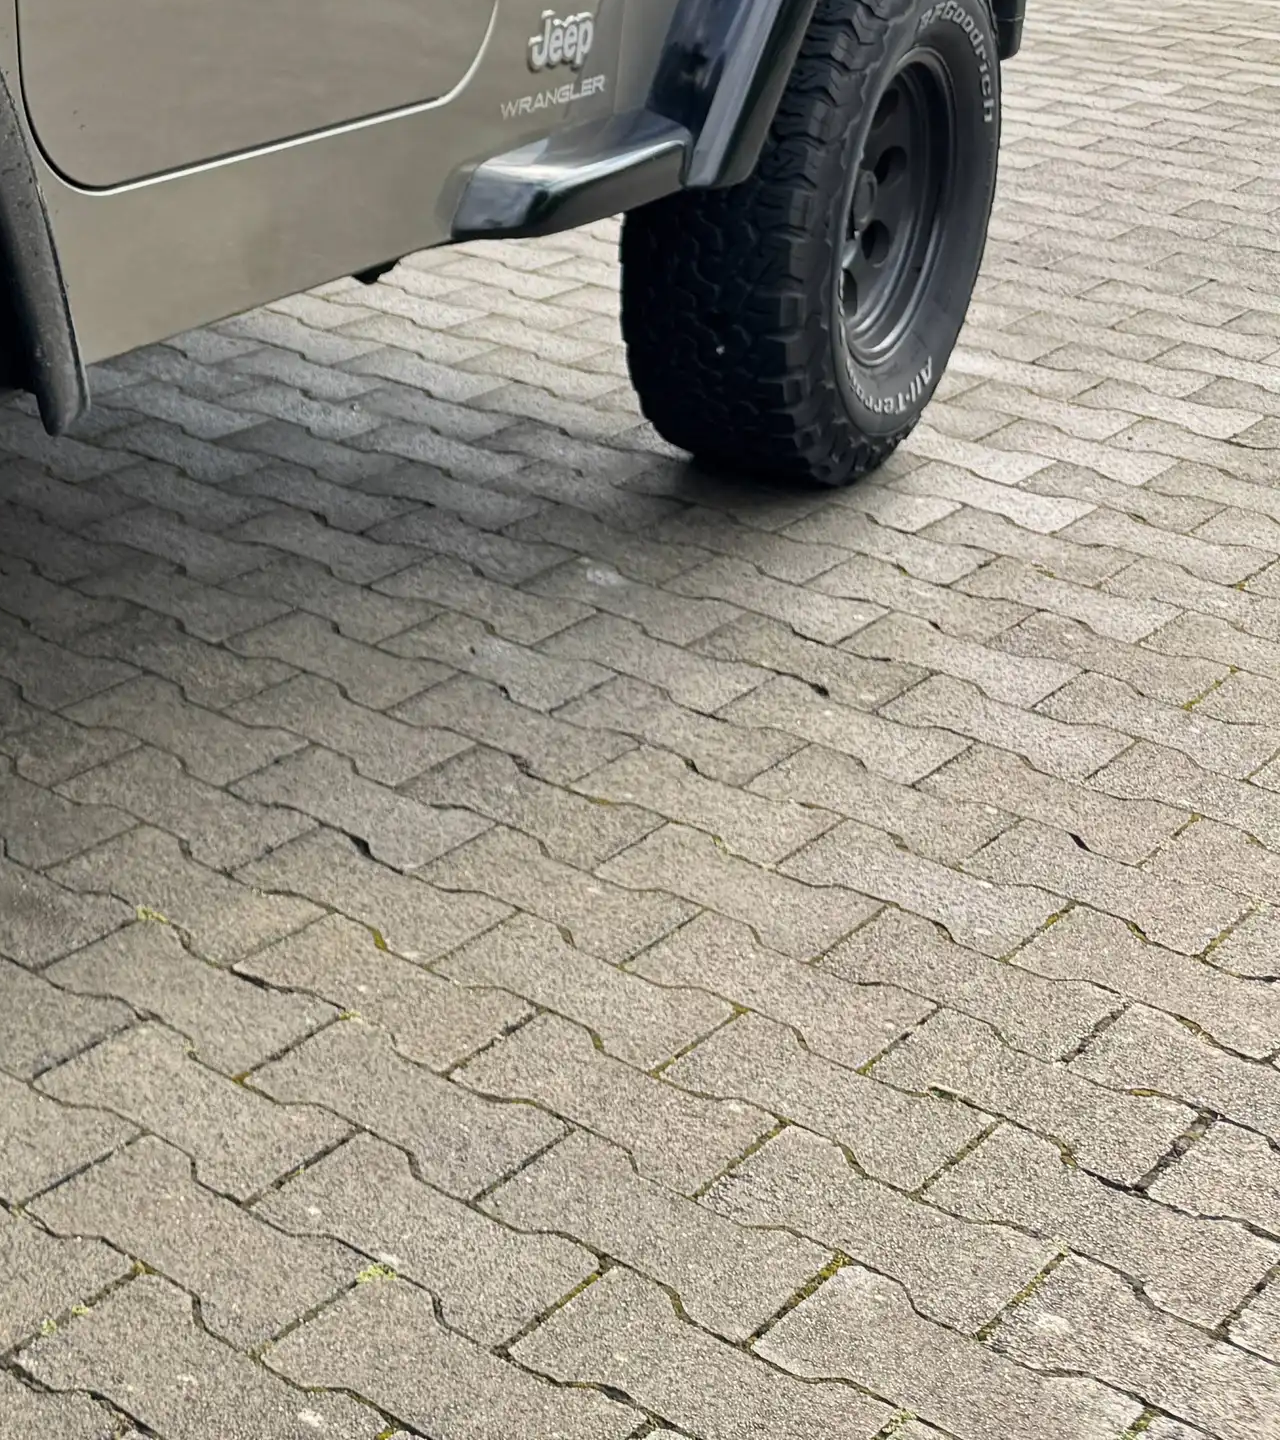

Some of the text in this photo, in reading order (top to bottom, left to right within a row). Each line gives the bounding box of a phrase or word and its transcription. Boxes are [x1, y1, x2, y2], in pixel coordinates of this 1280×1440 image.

[527, 9, 595, 72] Jeep
[918, 0, 995, 124] BFGoodrich
[500, 74, 607, 120] WRANGLER
